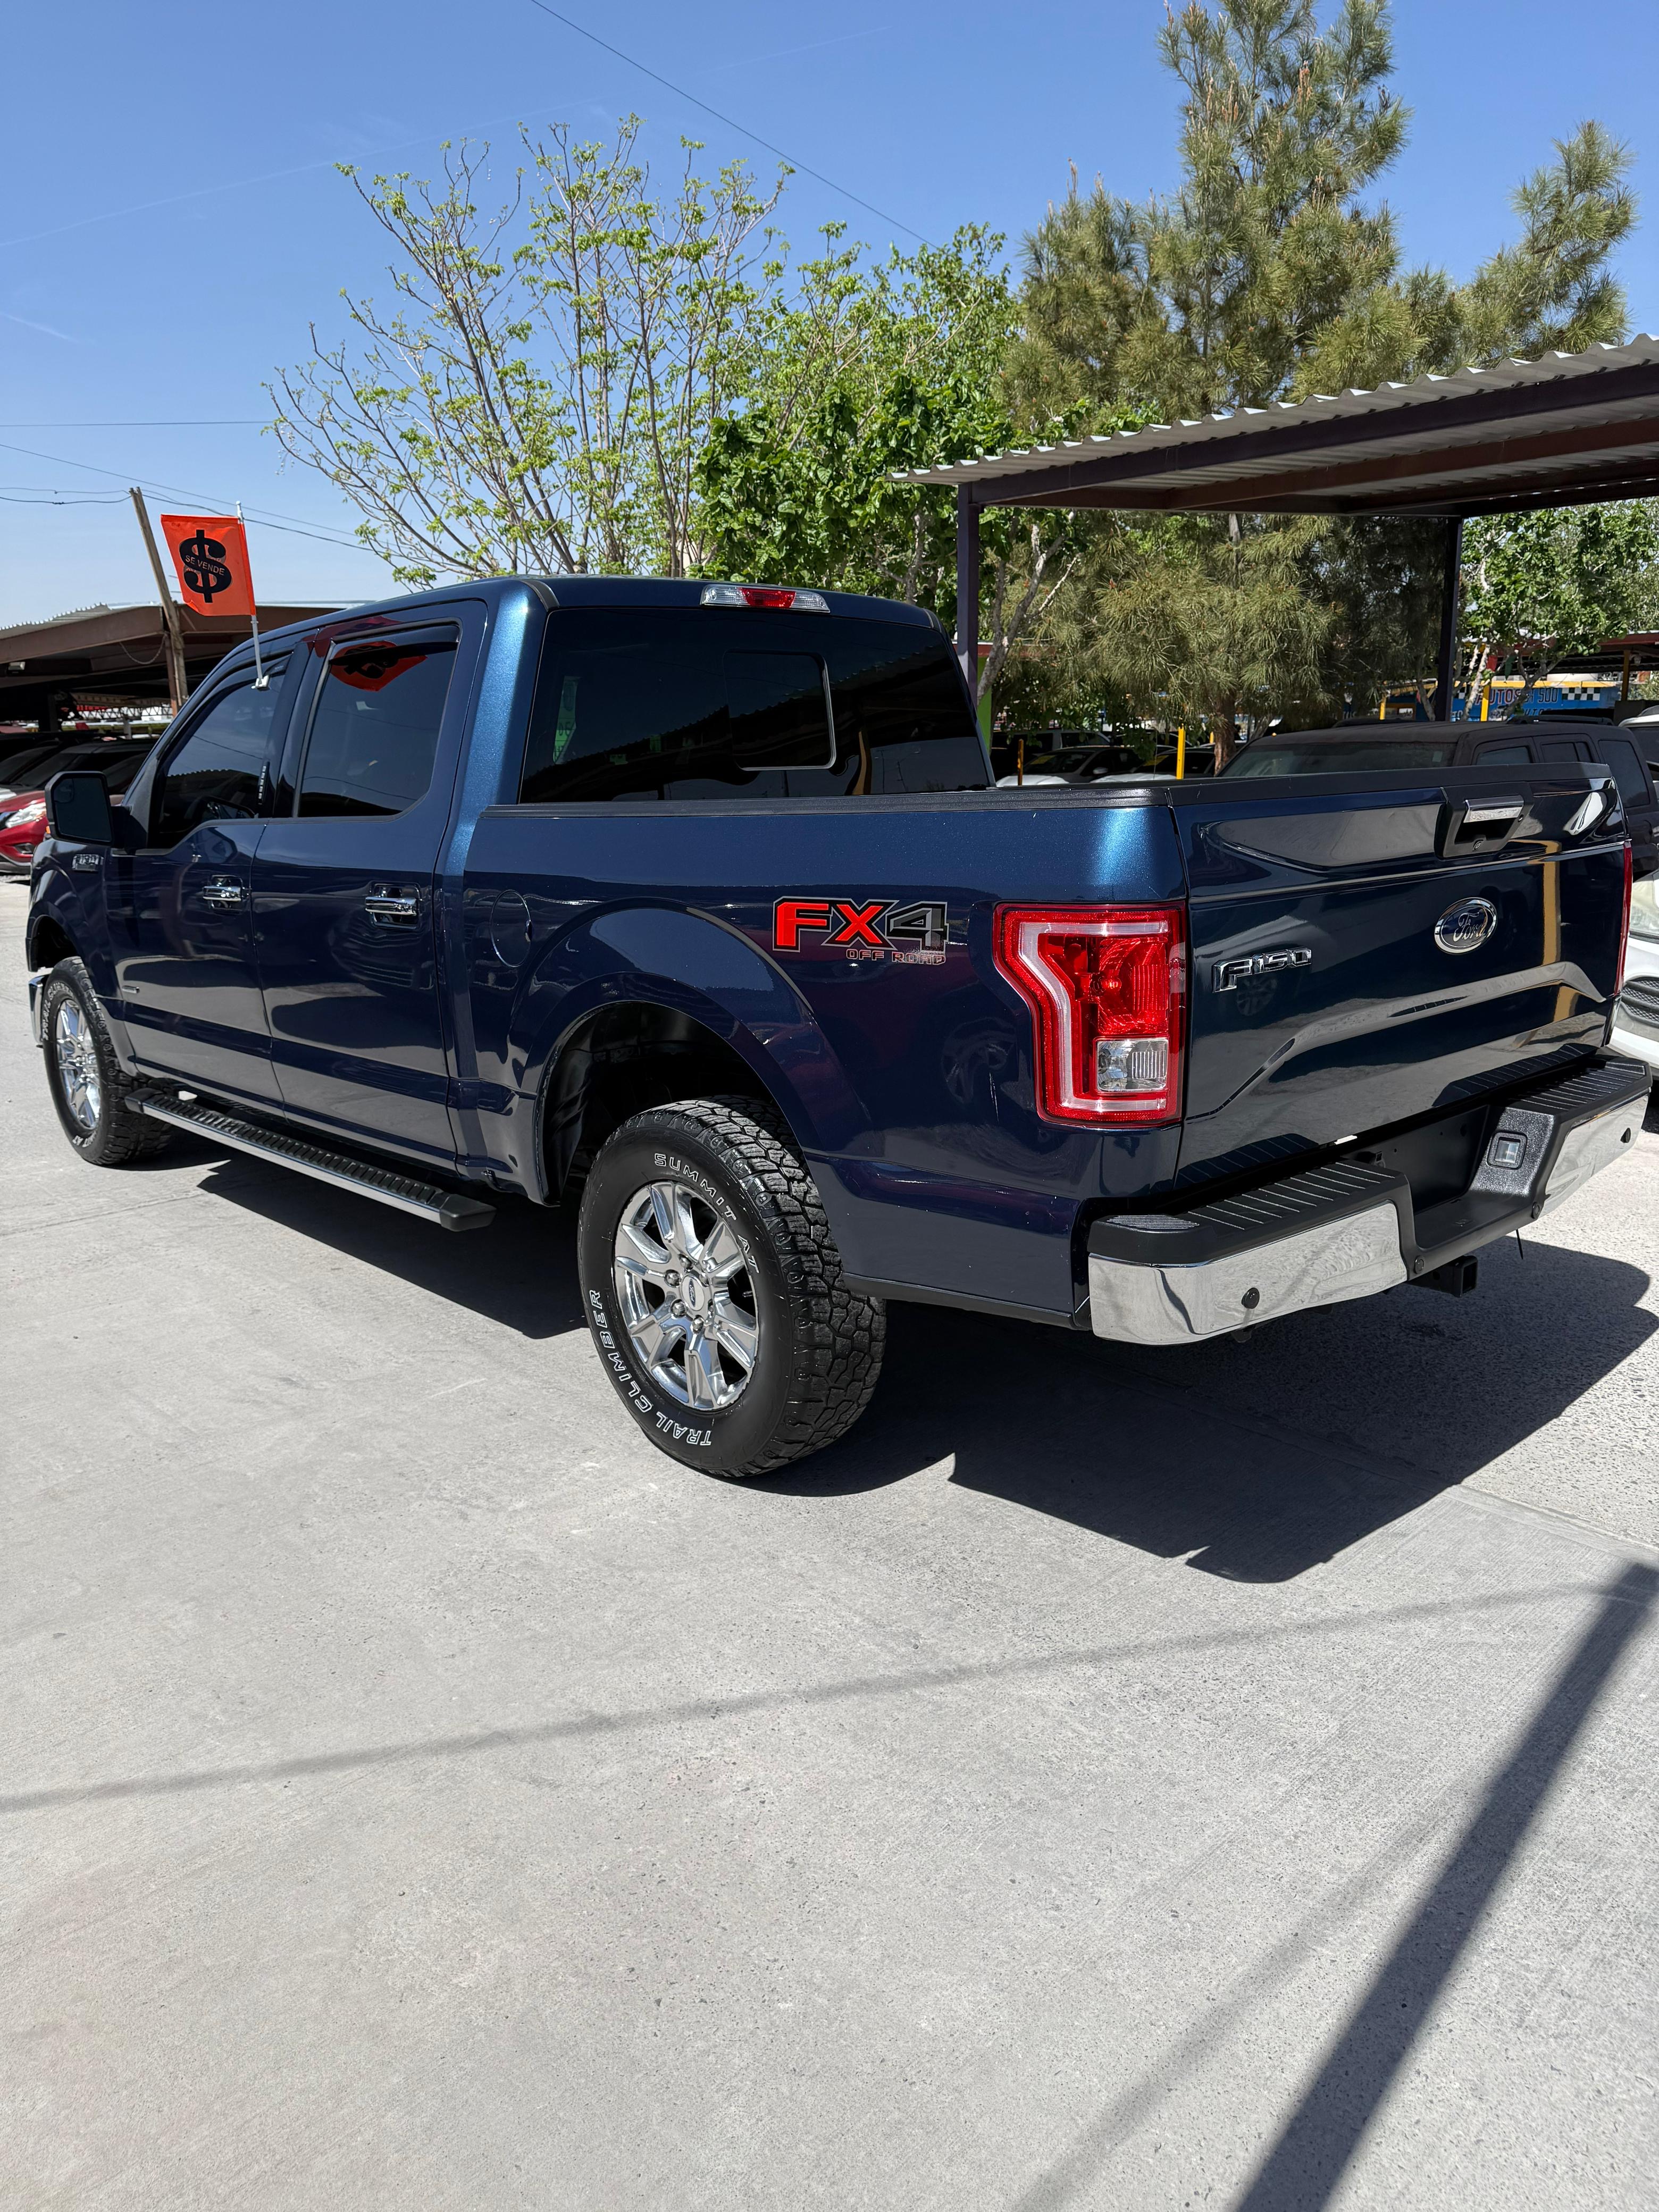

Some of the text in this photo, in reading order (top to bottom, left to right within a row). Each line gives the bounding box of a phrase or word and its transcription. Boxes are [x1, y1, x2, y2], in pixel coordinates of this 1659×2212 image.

[186, 555, 225, 575] SE VENDE
[1538, 688, 1558, 703] 500
[773, 896, 949, 953] FX4
[846, 949, 945, 965] OFF ROAD
[654, 1153, 738, 1221] SUMMIT
[738, 1234, 760, 1273] AT
[590, 1289, 654, 1413] CLIMBER
[656, 1411, 713, 1446] TRAIL
